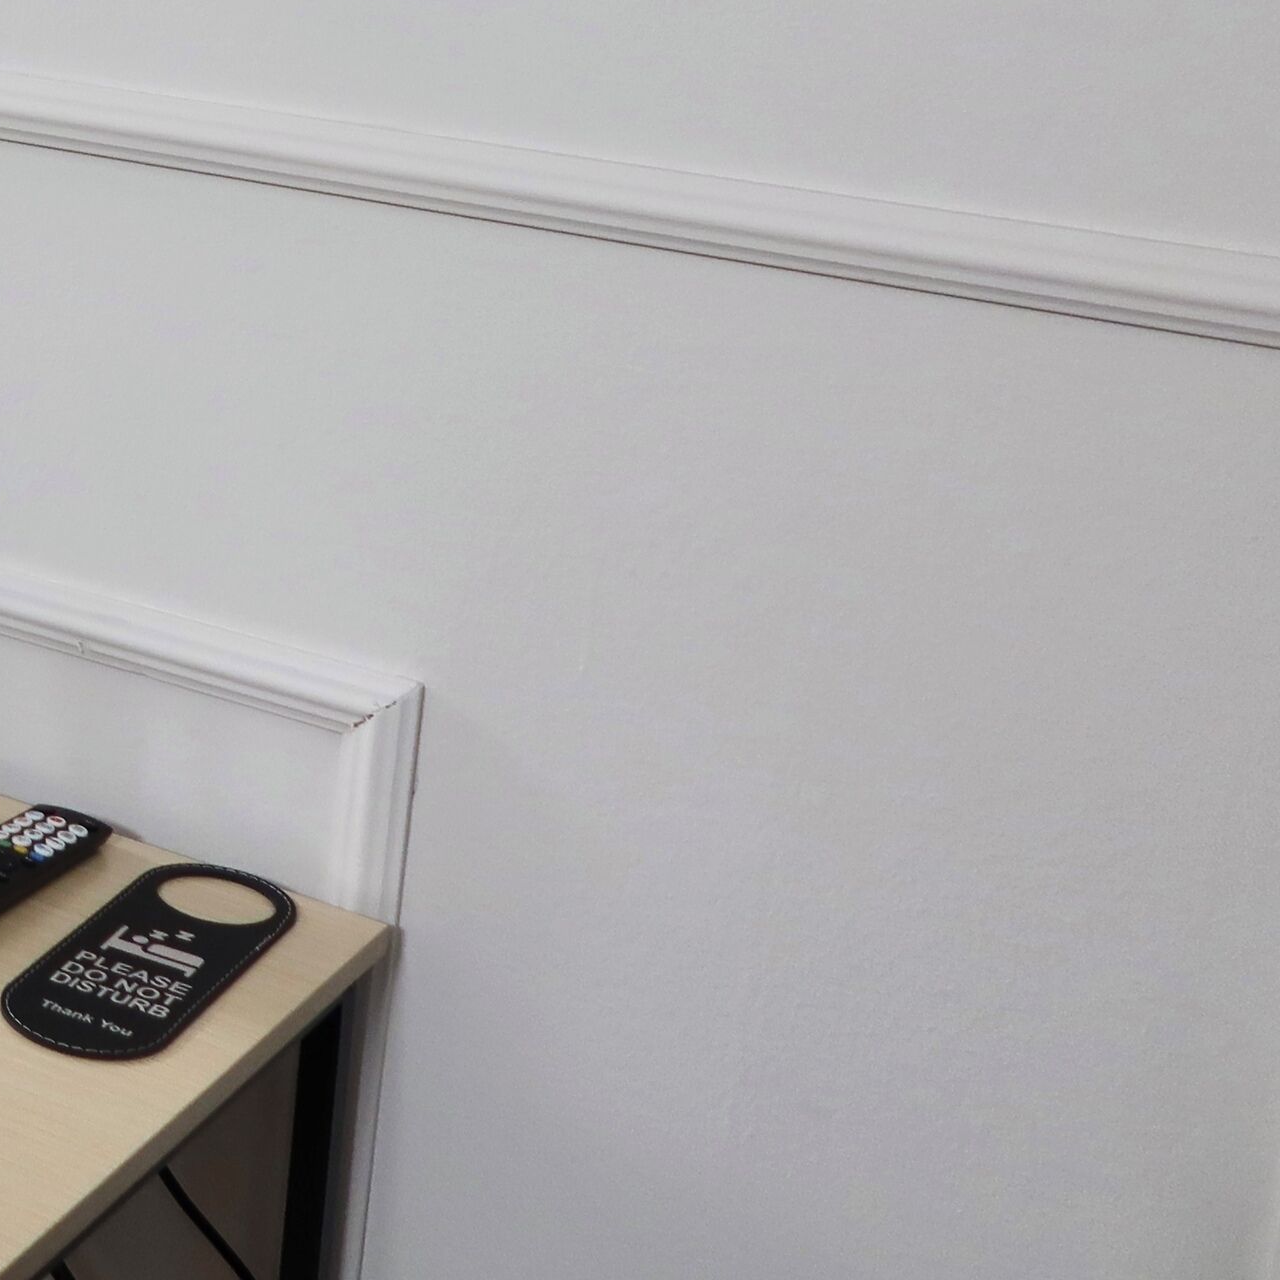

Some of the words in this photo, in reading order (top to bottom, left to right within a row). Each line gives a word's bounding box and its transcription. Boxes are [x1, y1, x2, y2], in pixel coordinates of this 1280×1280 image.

[49, 971, 171, 1018] DISTURB
[60, 960, 108, 982] DO
[114, 978, 183, 1006] NOT
[74, 950, 193, 996] PLEASE
[41, 998, 94, 1023] Thank
[101, 1019, 134, 1037] You
